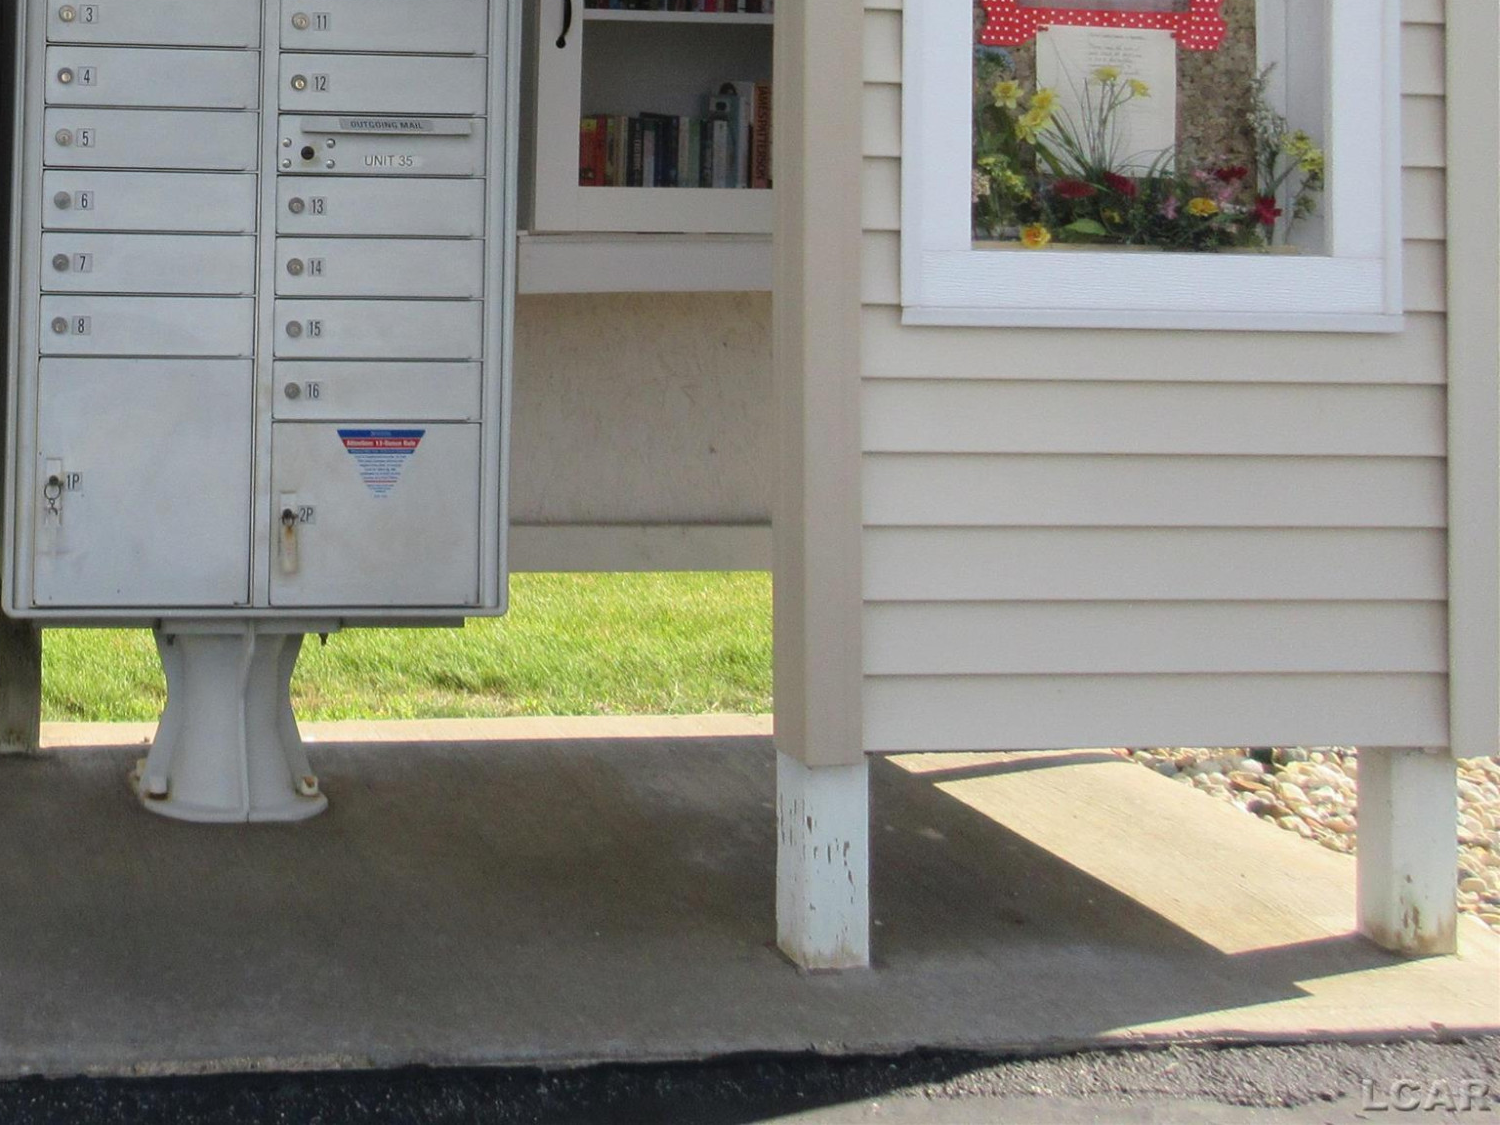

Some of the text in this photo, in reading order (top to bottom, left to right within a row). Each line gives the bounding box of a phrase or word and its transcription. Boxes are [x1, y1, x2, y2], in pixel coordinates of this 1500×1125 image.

[85, 7, 94, 23] 3
[316, 14, 328, 30] 11
[83, 69, 91, 84] 4
[314, 76, 326, 91] 12
[349, 120, 424, 130] OUTGOING MAIL
[756, 86, 768, 180] JAMES PATTERSON
[81, 131, 89, 147] 5
[364, 155, 413, 167] UNIT 35
[81, 193, 88, 209] 6
[311, 198, 324, 214] 13
[79, 255, 87, 272] 7
[310, 260, 322, 275] 14
[77, 317, 85, 334] 8
[308, 321, 321, 337] 15
[307, 383, 320, 399] 16
[67, 474, 80, 490] 1P
[299, 507, 314, 523] 2P
